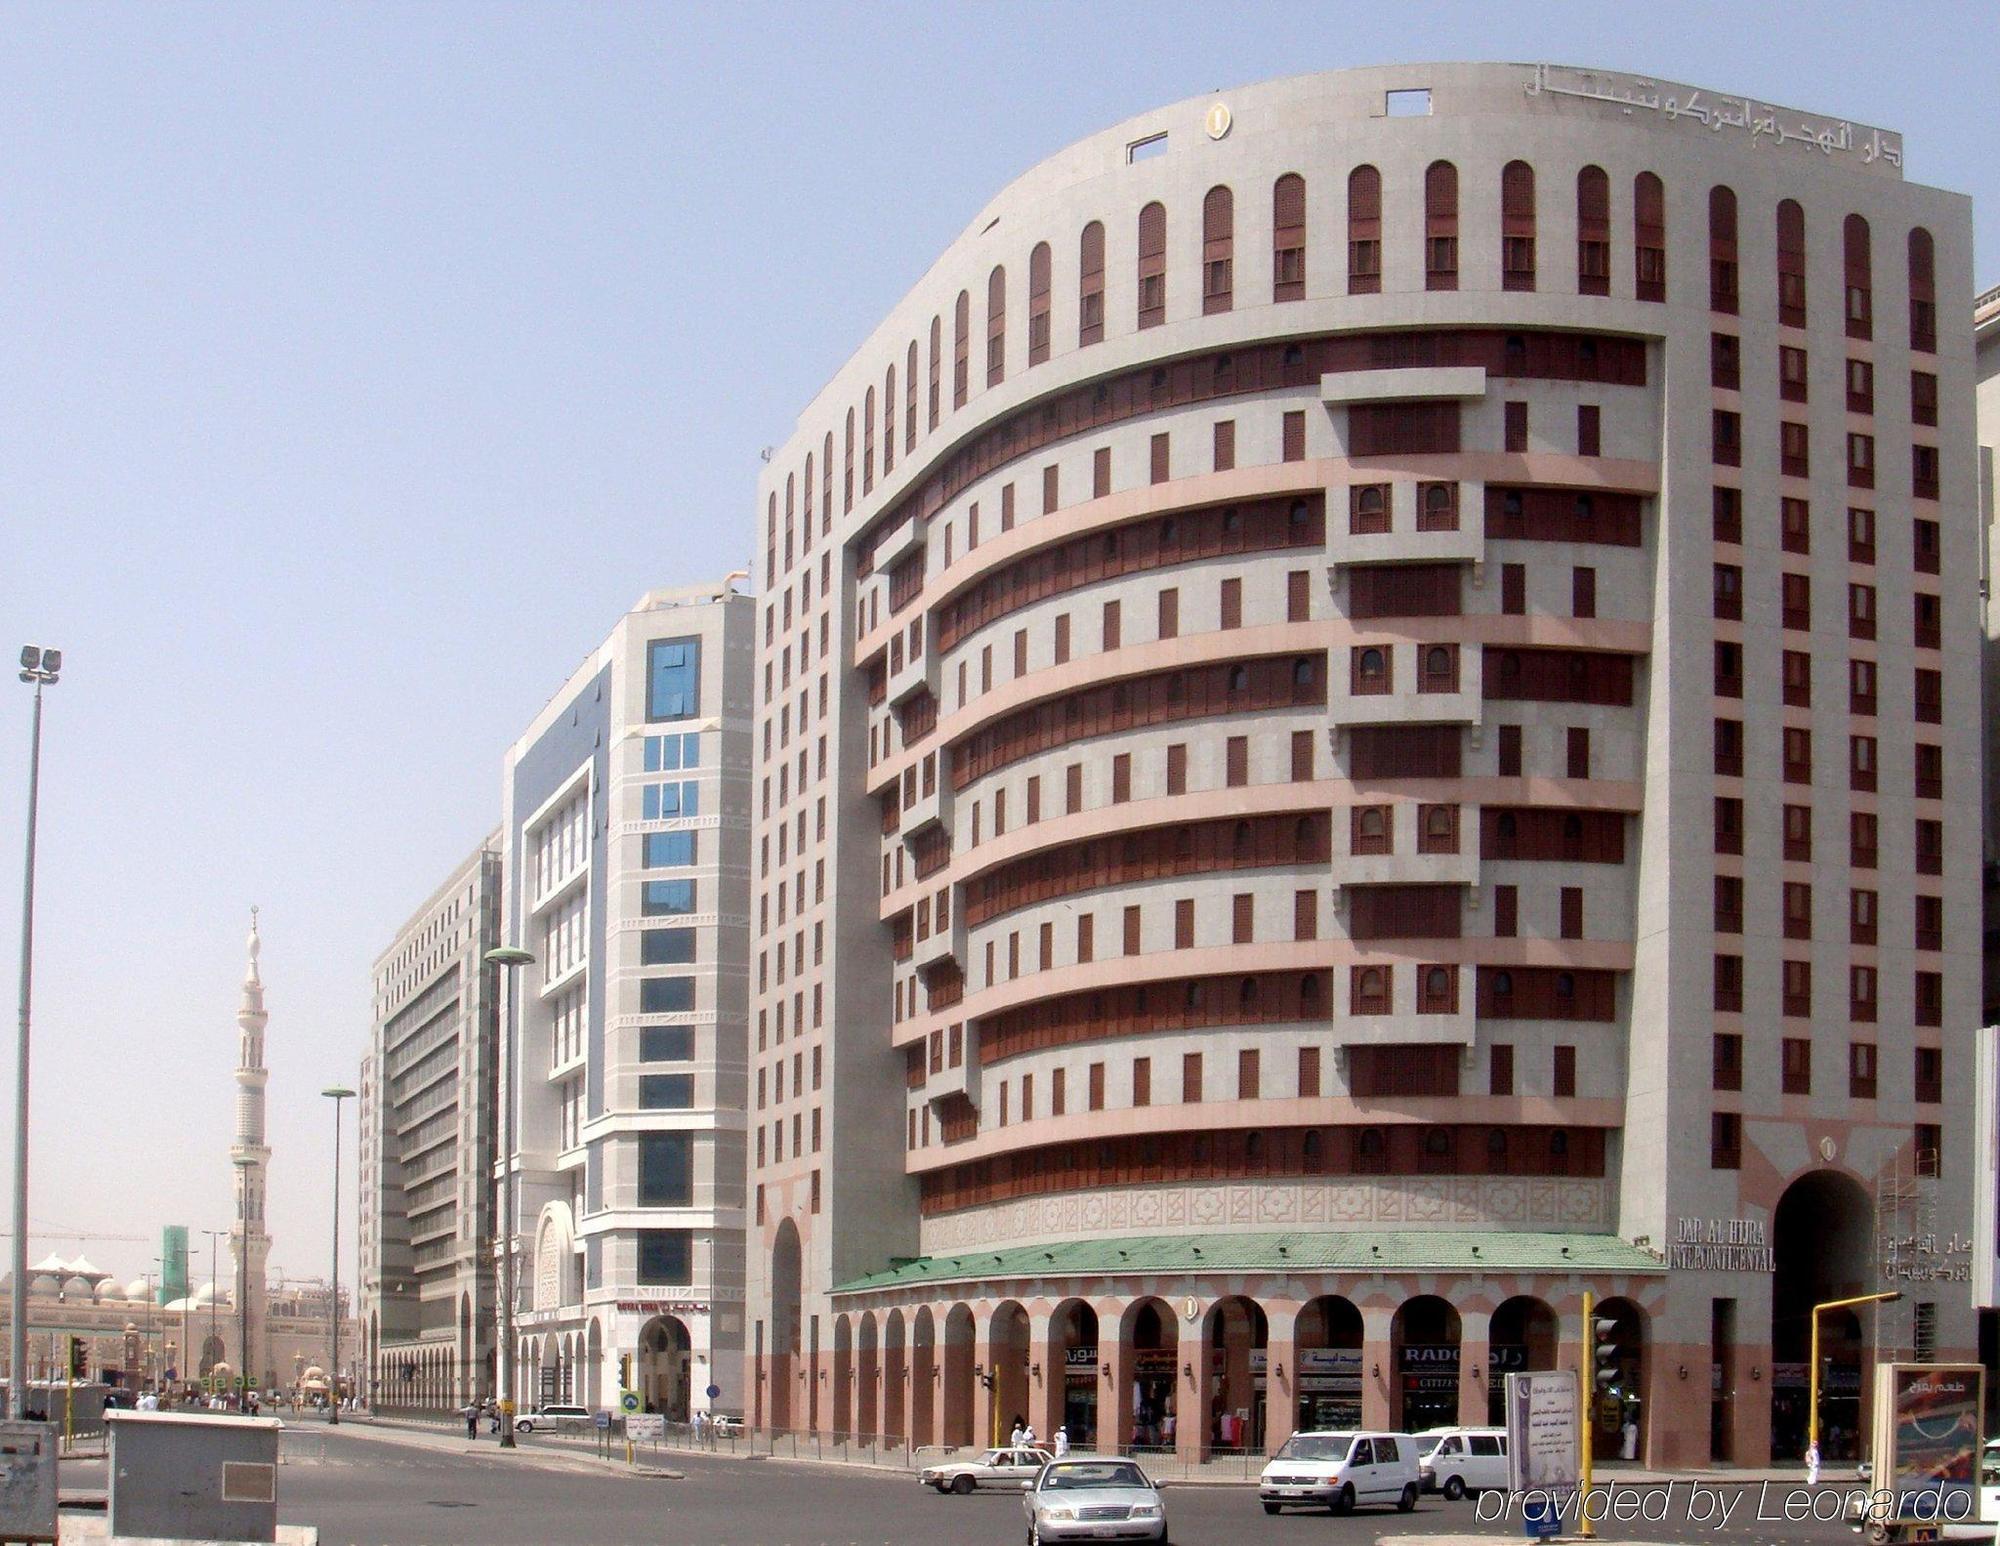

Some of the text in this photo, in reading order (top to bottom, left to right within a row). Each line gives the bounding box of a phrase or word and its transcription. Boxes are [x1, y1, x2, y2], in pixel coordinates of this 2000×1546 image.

[1678, 1217, 1765, 1245] DAR AL HIJRA
[1666, 1244, 1776, 1272] INTERCONTINENTAL
